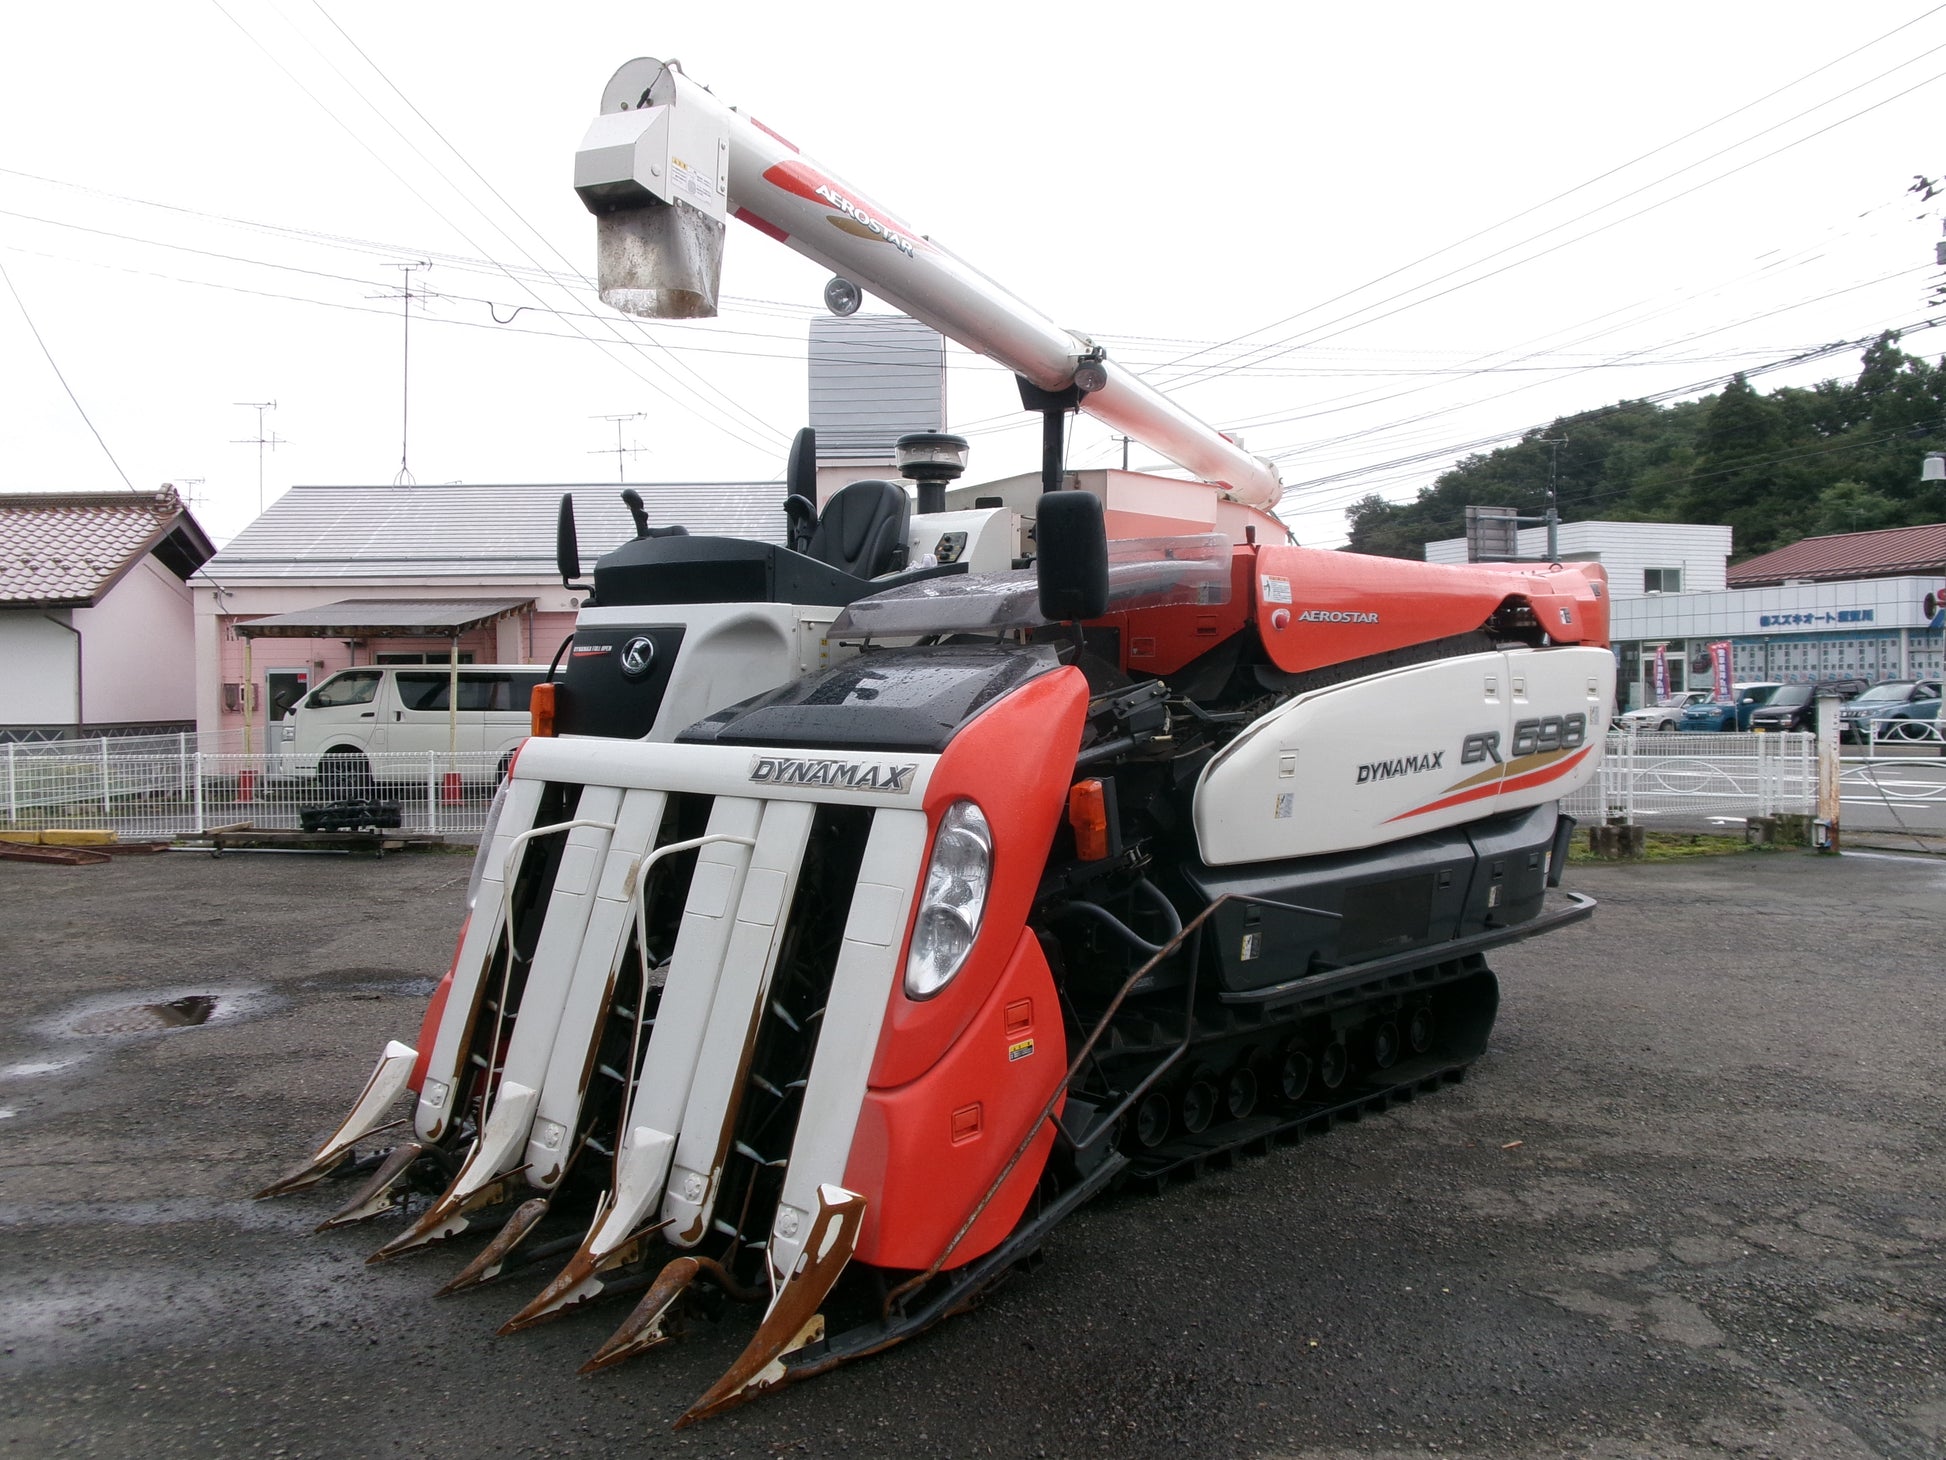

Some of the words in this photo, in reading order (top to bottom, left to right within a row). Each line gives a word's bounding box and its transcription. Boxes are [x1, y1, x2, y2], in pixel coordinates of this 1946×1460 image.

[816, 184, 914, 258] AEROSTAR
[1297, 610, 1379, 624] AEROSTAR
[1461, 731, 1502, 766] ER
[1511, 712, 1587, 757] 698
[750, 757, 914, 790] DYNAMAX
[1356, 751, 1446, 785] DYNAMAX
